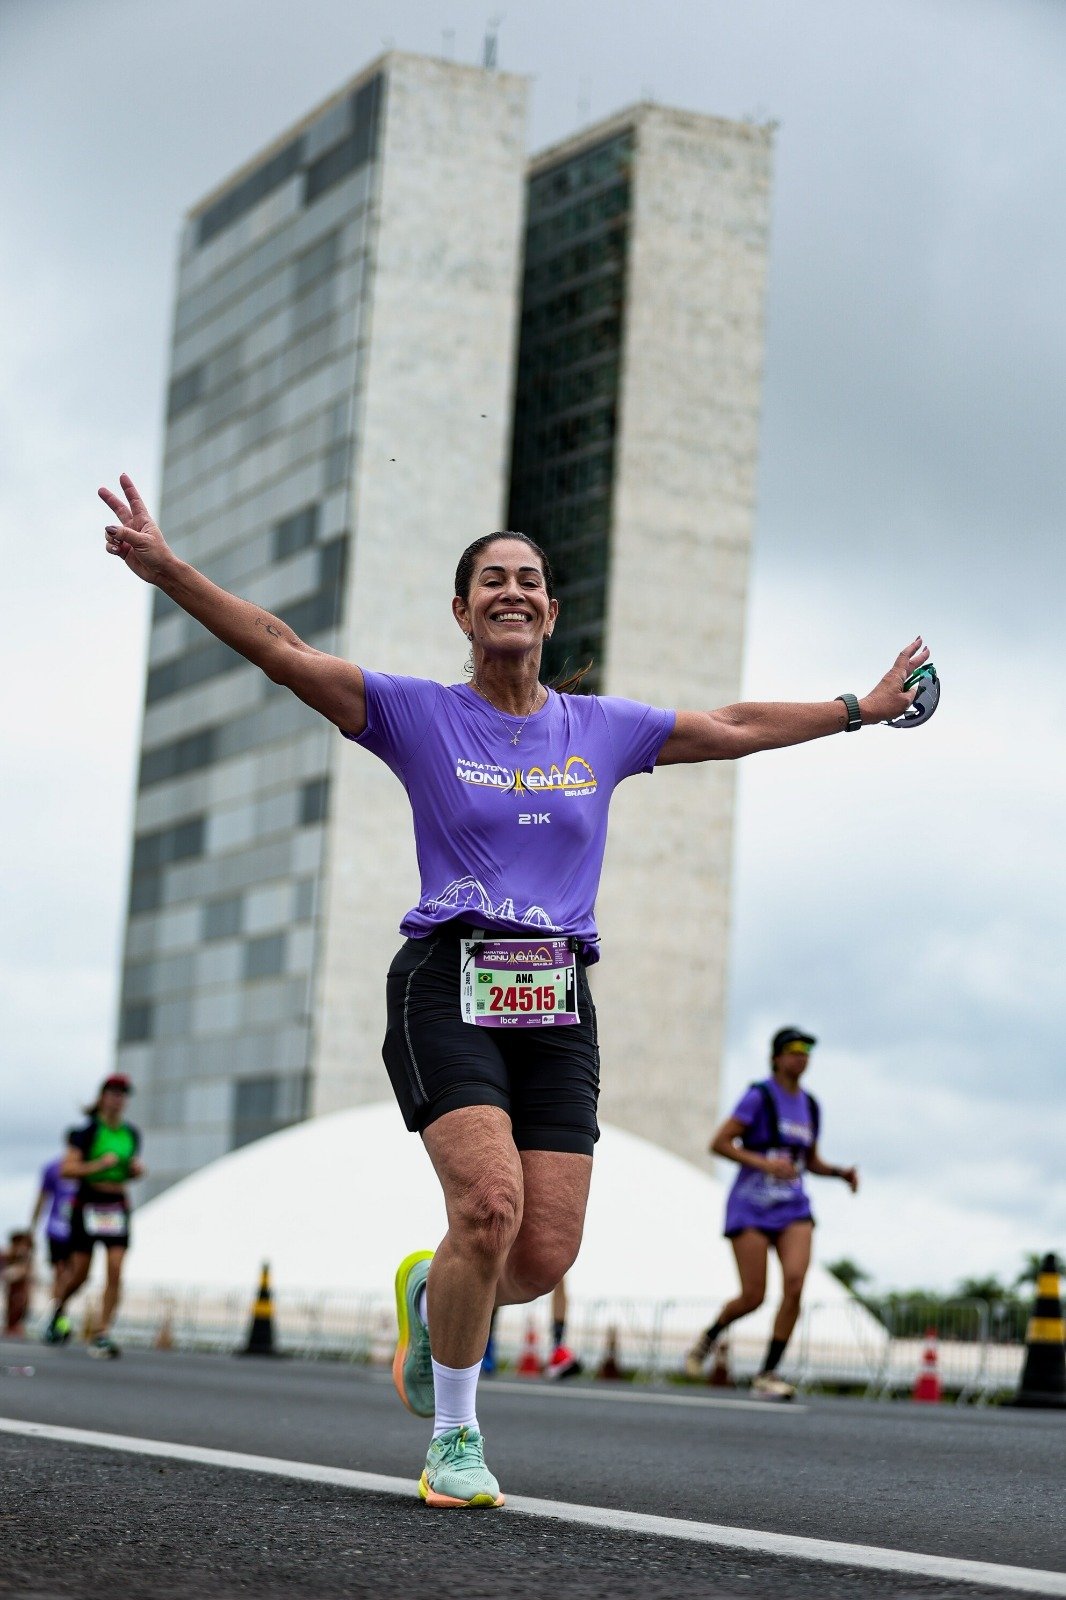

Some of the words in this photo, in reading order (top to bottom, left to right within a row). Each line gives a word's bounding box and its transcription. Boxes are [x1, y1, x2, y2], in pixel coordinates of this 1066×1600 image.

[458, 758, 509, 773] MARATONA
[518, 813, 551, 825] 21K
[515, 973, 534, 984] ANA
[489, 985, 556, 1012] 24515
